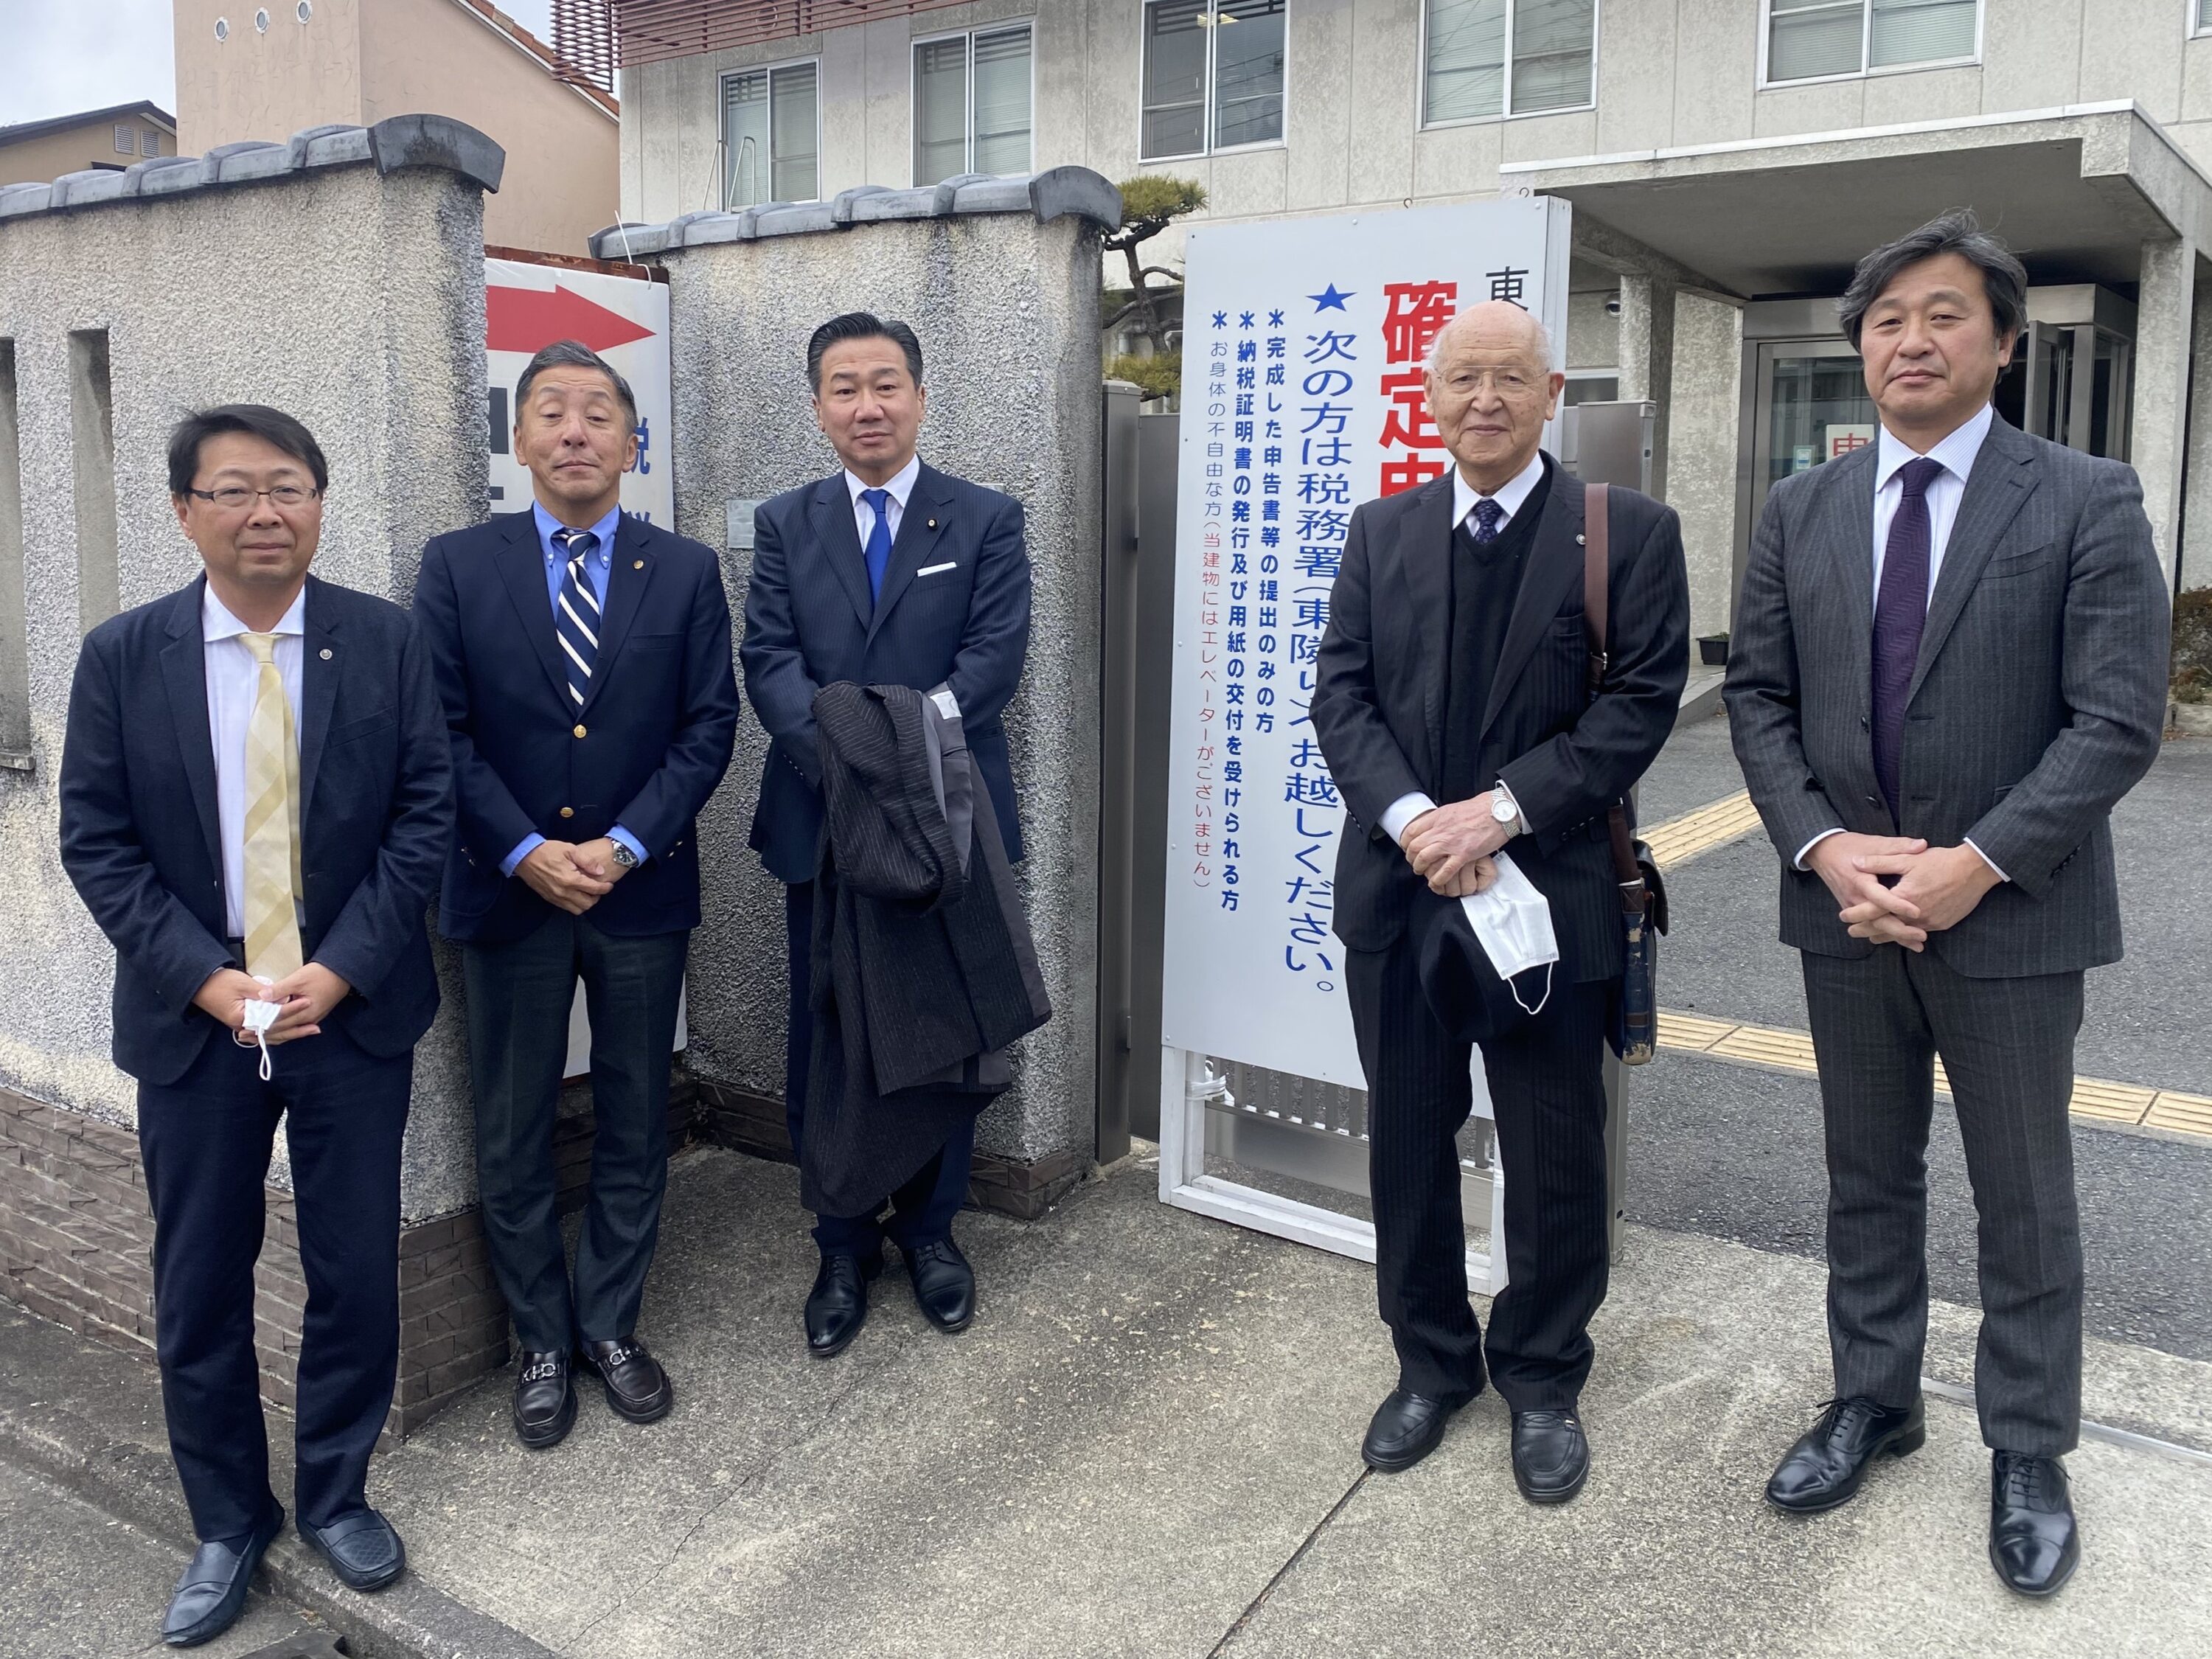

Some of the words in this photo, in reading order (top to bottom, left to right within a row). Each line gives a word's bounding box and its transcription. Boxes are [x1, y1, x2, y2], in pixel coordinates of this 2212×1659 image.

[1486, 266, 1528, 311] 東
[1221, 339, 1256, 911] 納税証明書の発行及び用紙の交付を受けられる方
[1256, 336, 1286, 733] 完成した申告書等の提出のみの方
